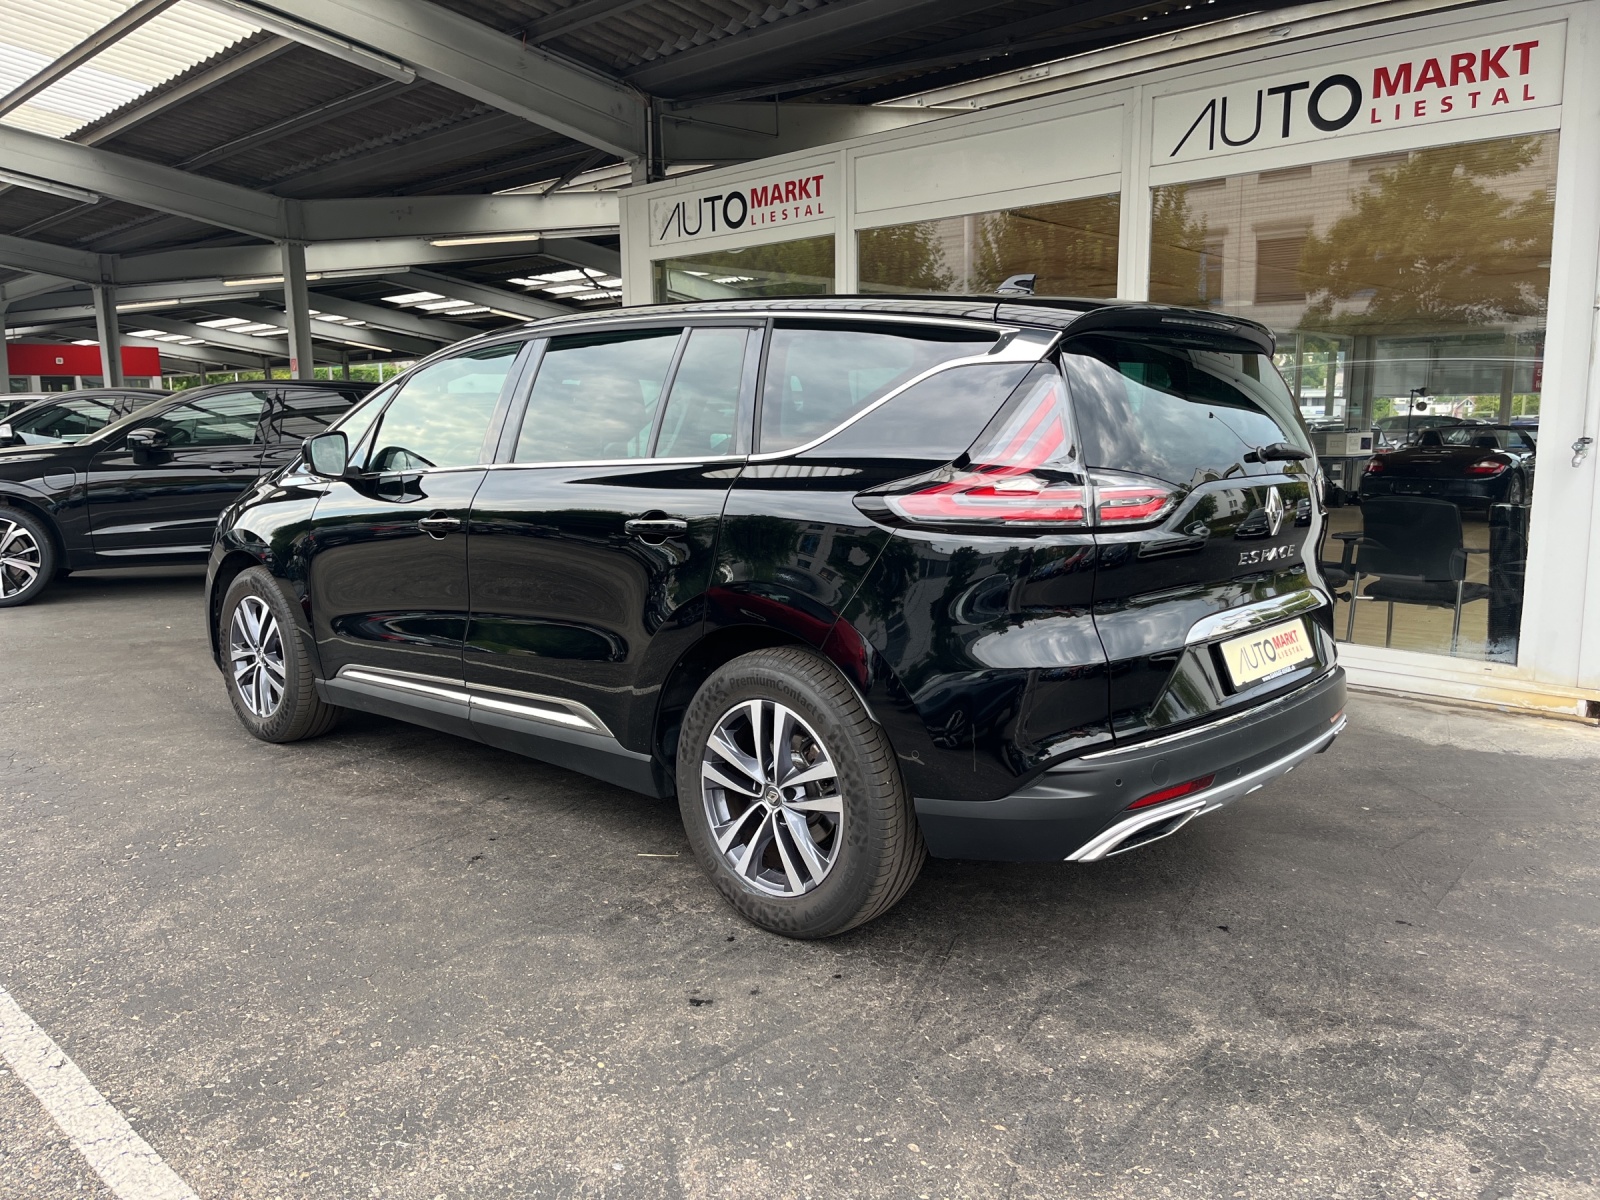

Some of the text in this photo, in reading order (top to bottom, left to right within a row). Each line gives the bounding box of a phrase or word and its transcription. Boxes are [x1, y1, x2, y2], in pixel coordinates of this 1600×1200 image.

[1169, 40, 1540, 158] AUTO MARKT
[1370, 83, 1536, 125] LIESTAL
[659, 174, 824, 241] AUTO MARKT
[750, 202, 825, 226] LIESTAL
[1237, 544, 1296, 566] ESPACE
[1239, 638, 1278, 675] AUTO
[1271, 629, 1299, 650] MARKT
[1277, 644, 1304, 660] LIESTAL
[729, 673, 818, 717] PremiumContact
